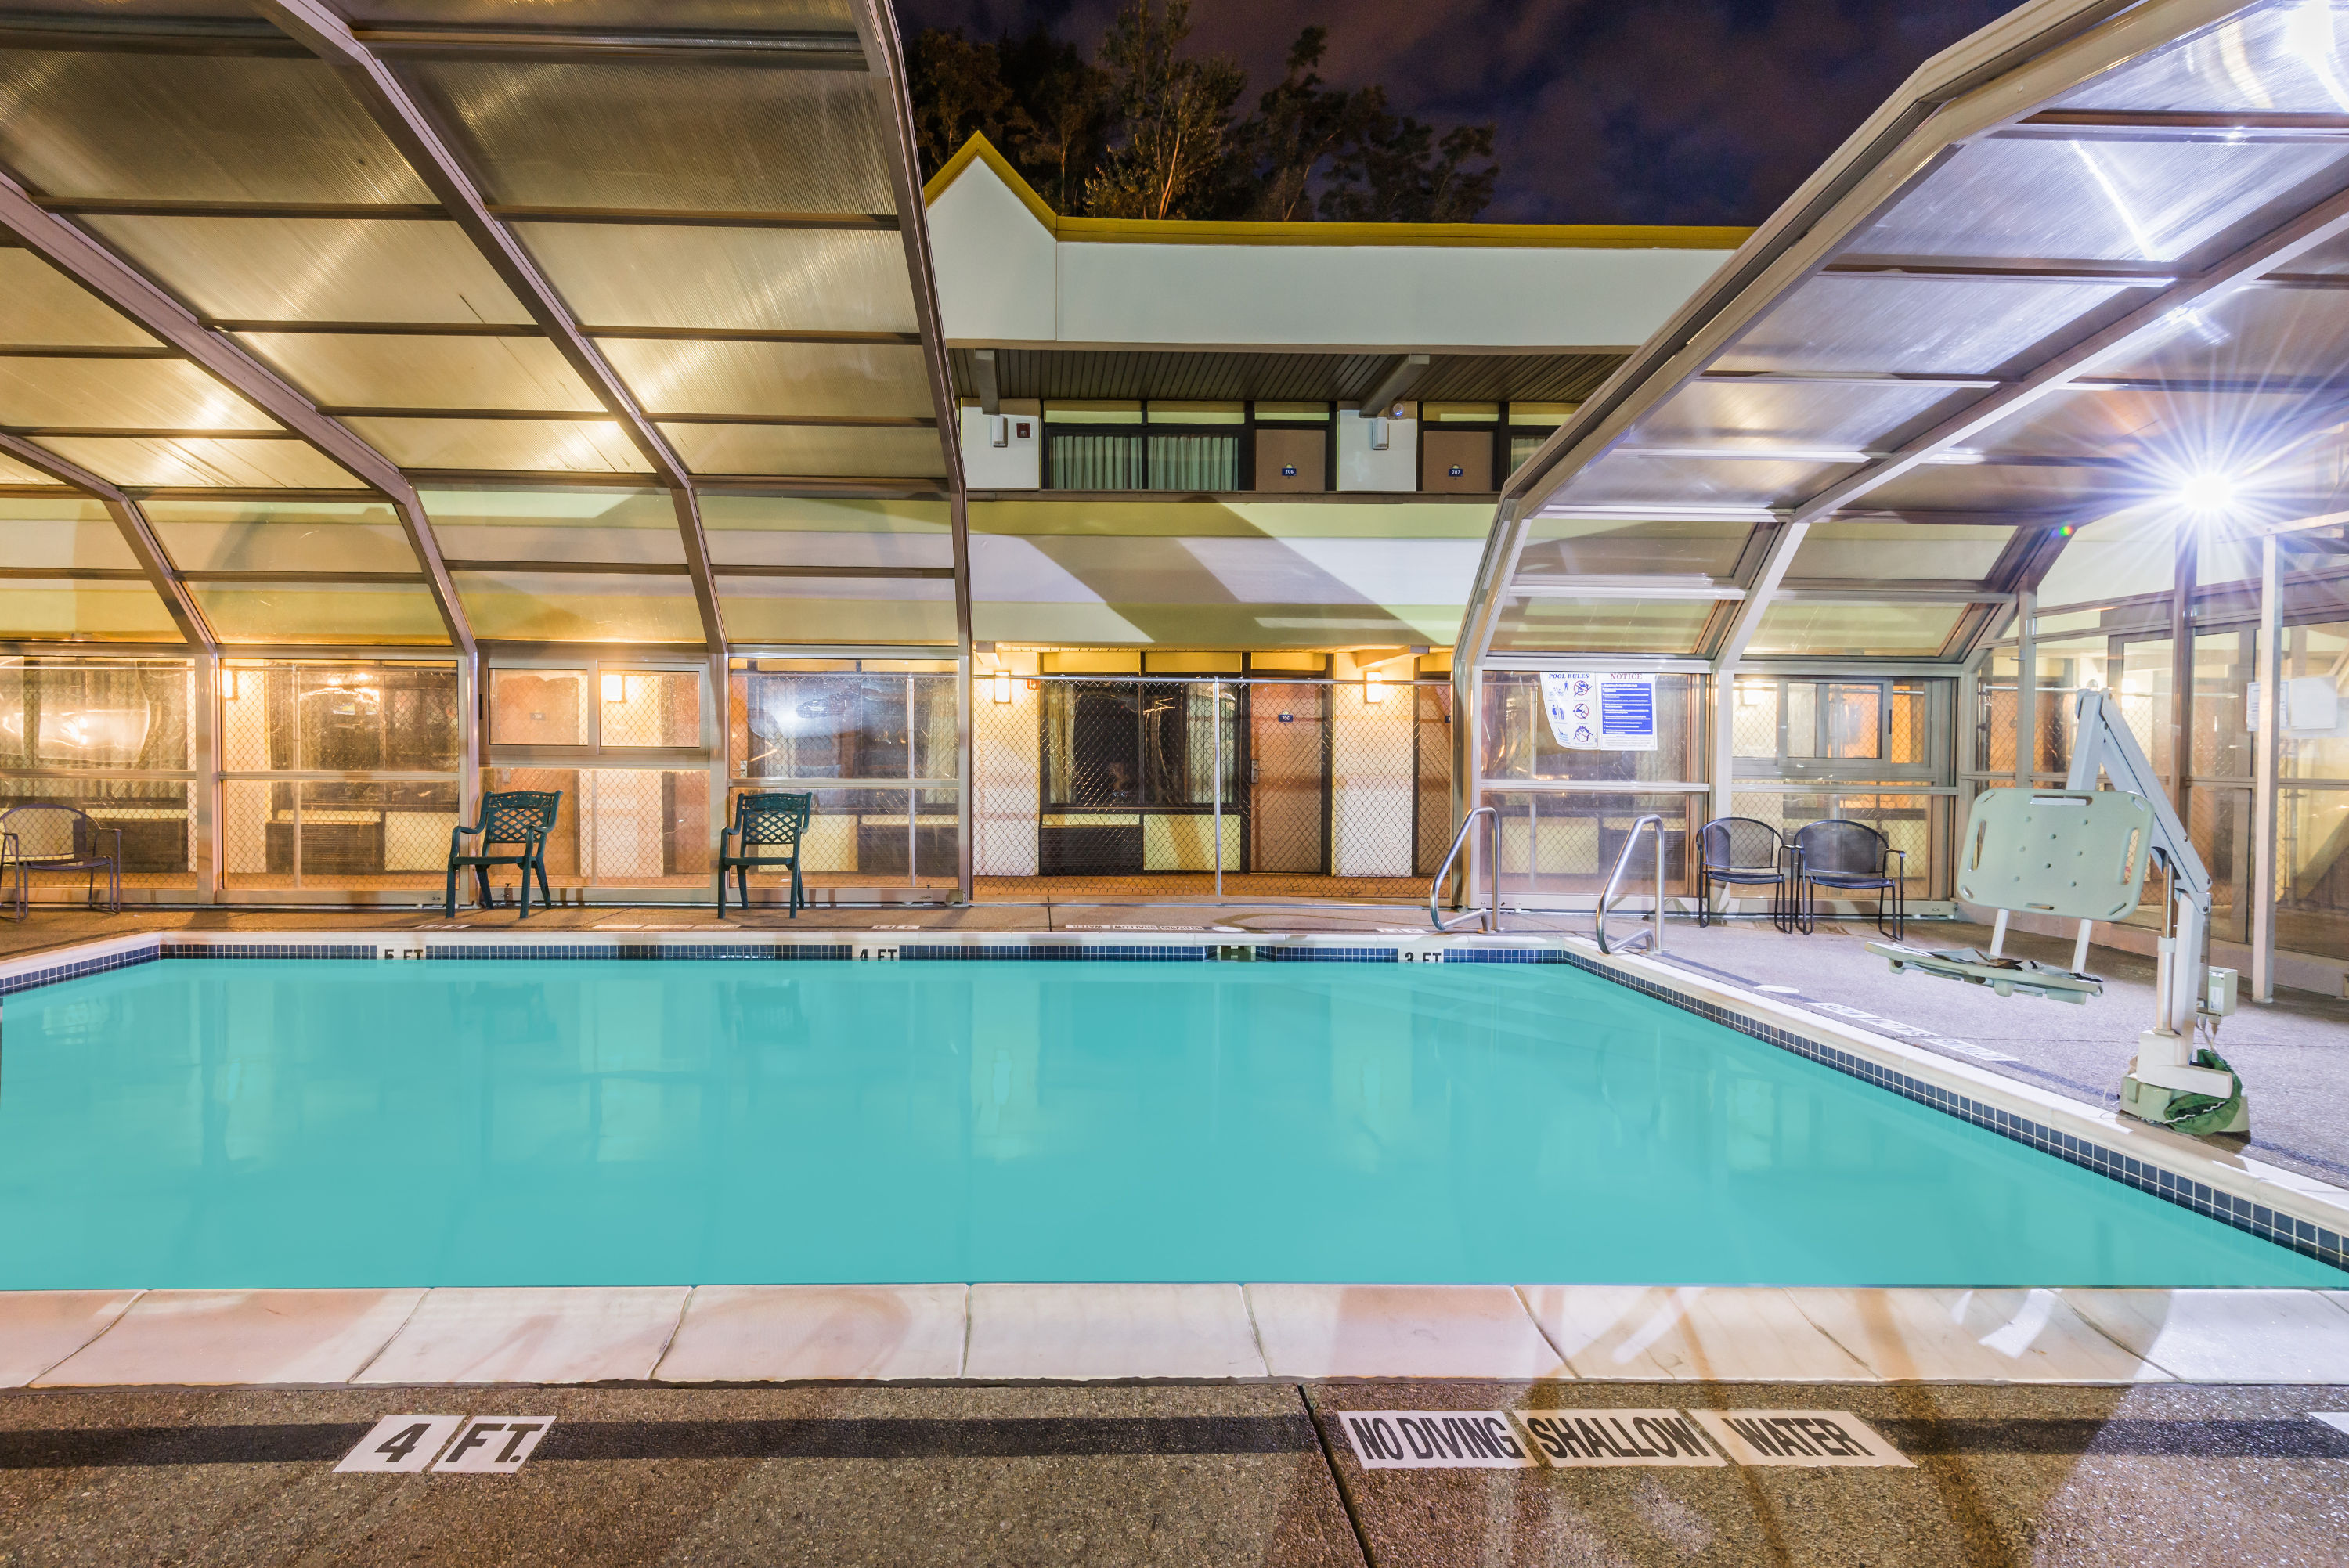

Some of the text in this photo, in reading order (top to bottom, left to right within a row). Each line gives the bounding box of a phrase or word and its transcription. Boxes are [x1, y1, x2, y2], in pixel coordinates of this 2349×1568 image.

[403, 949, 424, 960] FT
[877, 949, 897, 959] FT
[1422, 952, 1442, 962] FT
[374, 1423, 545, 1463] 4 FT.
[1348, 1417, 1876, 1461] NO DIVING SHALLOW WATER
